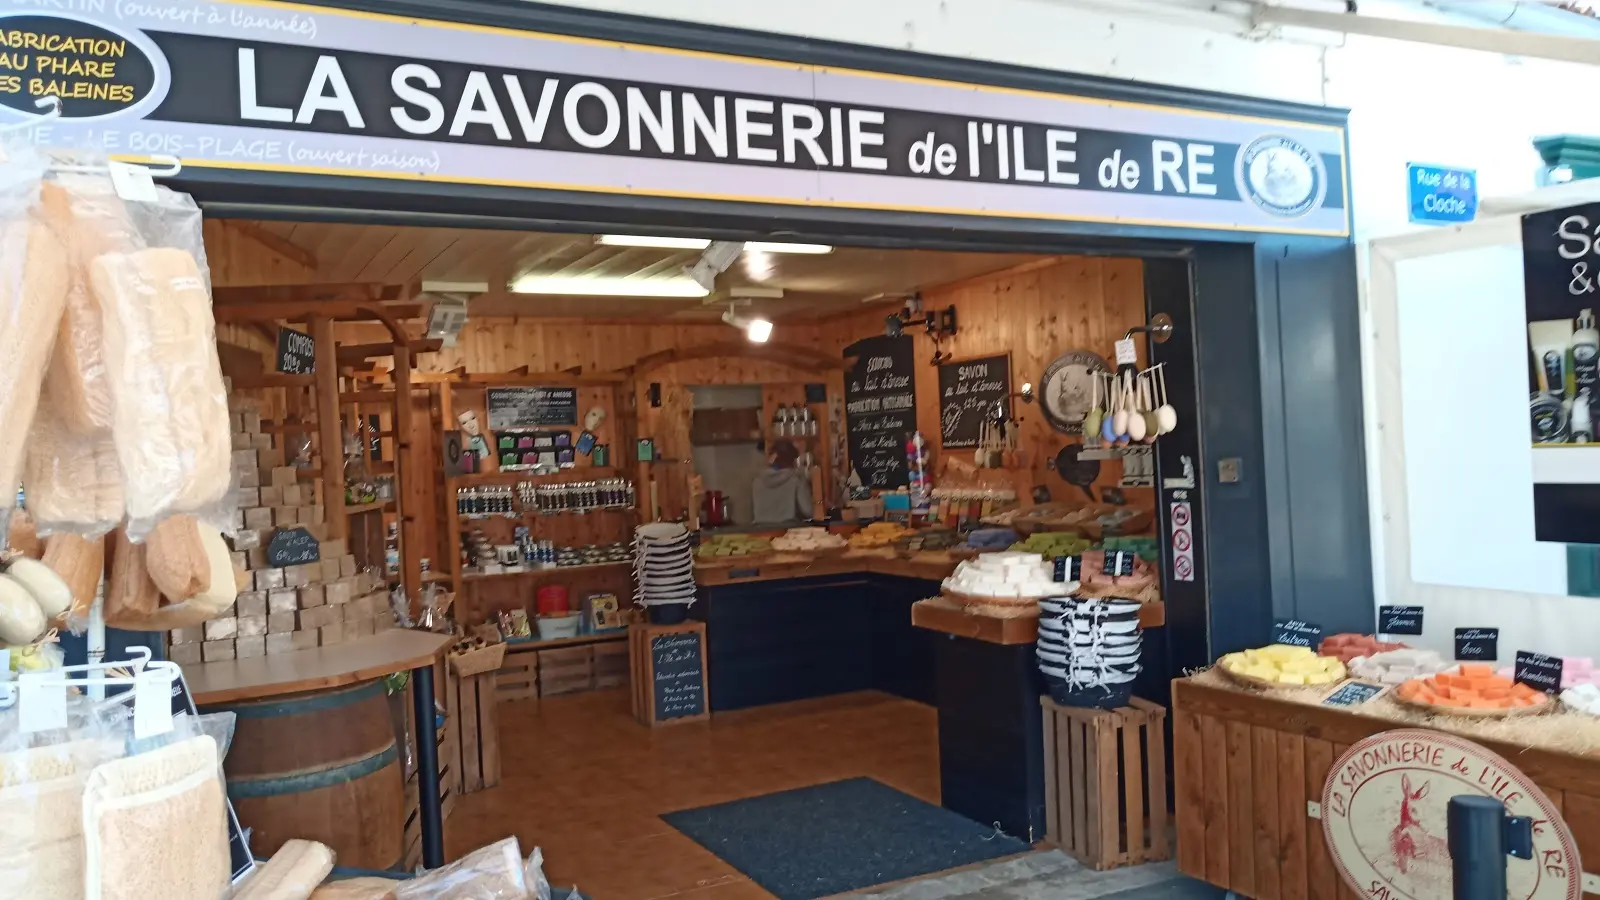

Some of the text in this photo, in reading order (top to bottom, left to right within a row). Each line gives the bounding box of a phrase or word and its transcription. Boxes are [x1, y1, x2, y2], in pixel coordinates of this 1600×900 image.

[208, 5, 225, 23] à
[0, 52, 116, 79] AU PHARE
[29, 78, 134, 102] BALEINES
[238, 47, 365, 129] LA
[391, 63, 888, 171] SAVONNERIE
[908, 131, 957, 176] de
[1098, 148, 1140, 190] de
[1152, 139, 1218, 196] RE
[129, 131, 282, 159] BOIS-PLAGE
[288, 140, 369, 166] (ouvert
[371, 150, 441, 172] saison)
[1416, 168, 1471, 190] Rue de la
[1423, 193, 1467, 215] Cloche
[1557, 214, 1600, 260] S
[958, 363, 988, 381] SAVON
[1332, 792, 1346, 818] LA
[1341, 742, 1445, 792] SAVONNERIE
[1450, 756, 1469, 776] de
[1478, 766, 1524, 809] L'ILE
[1541, 849, 1566, 878] RE
